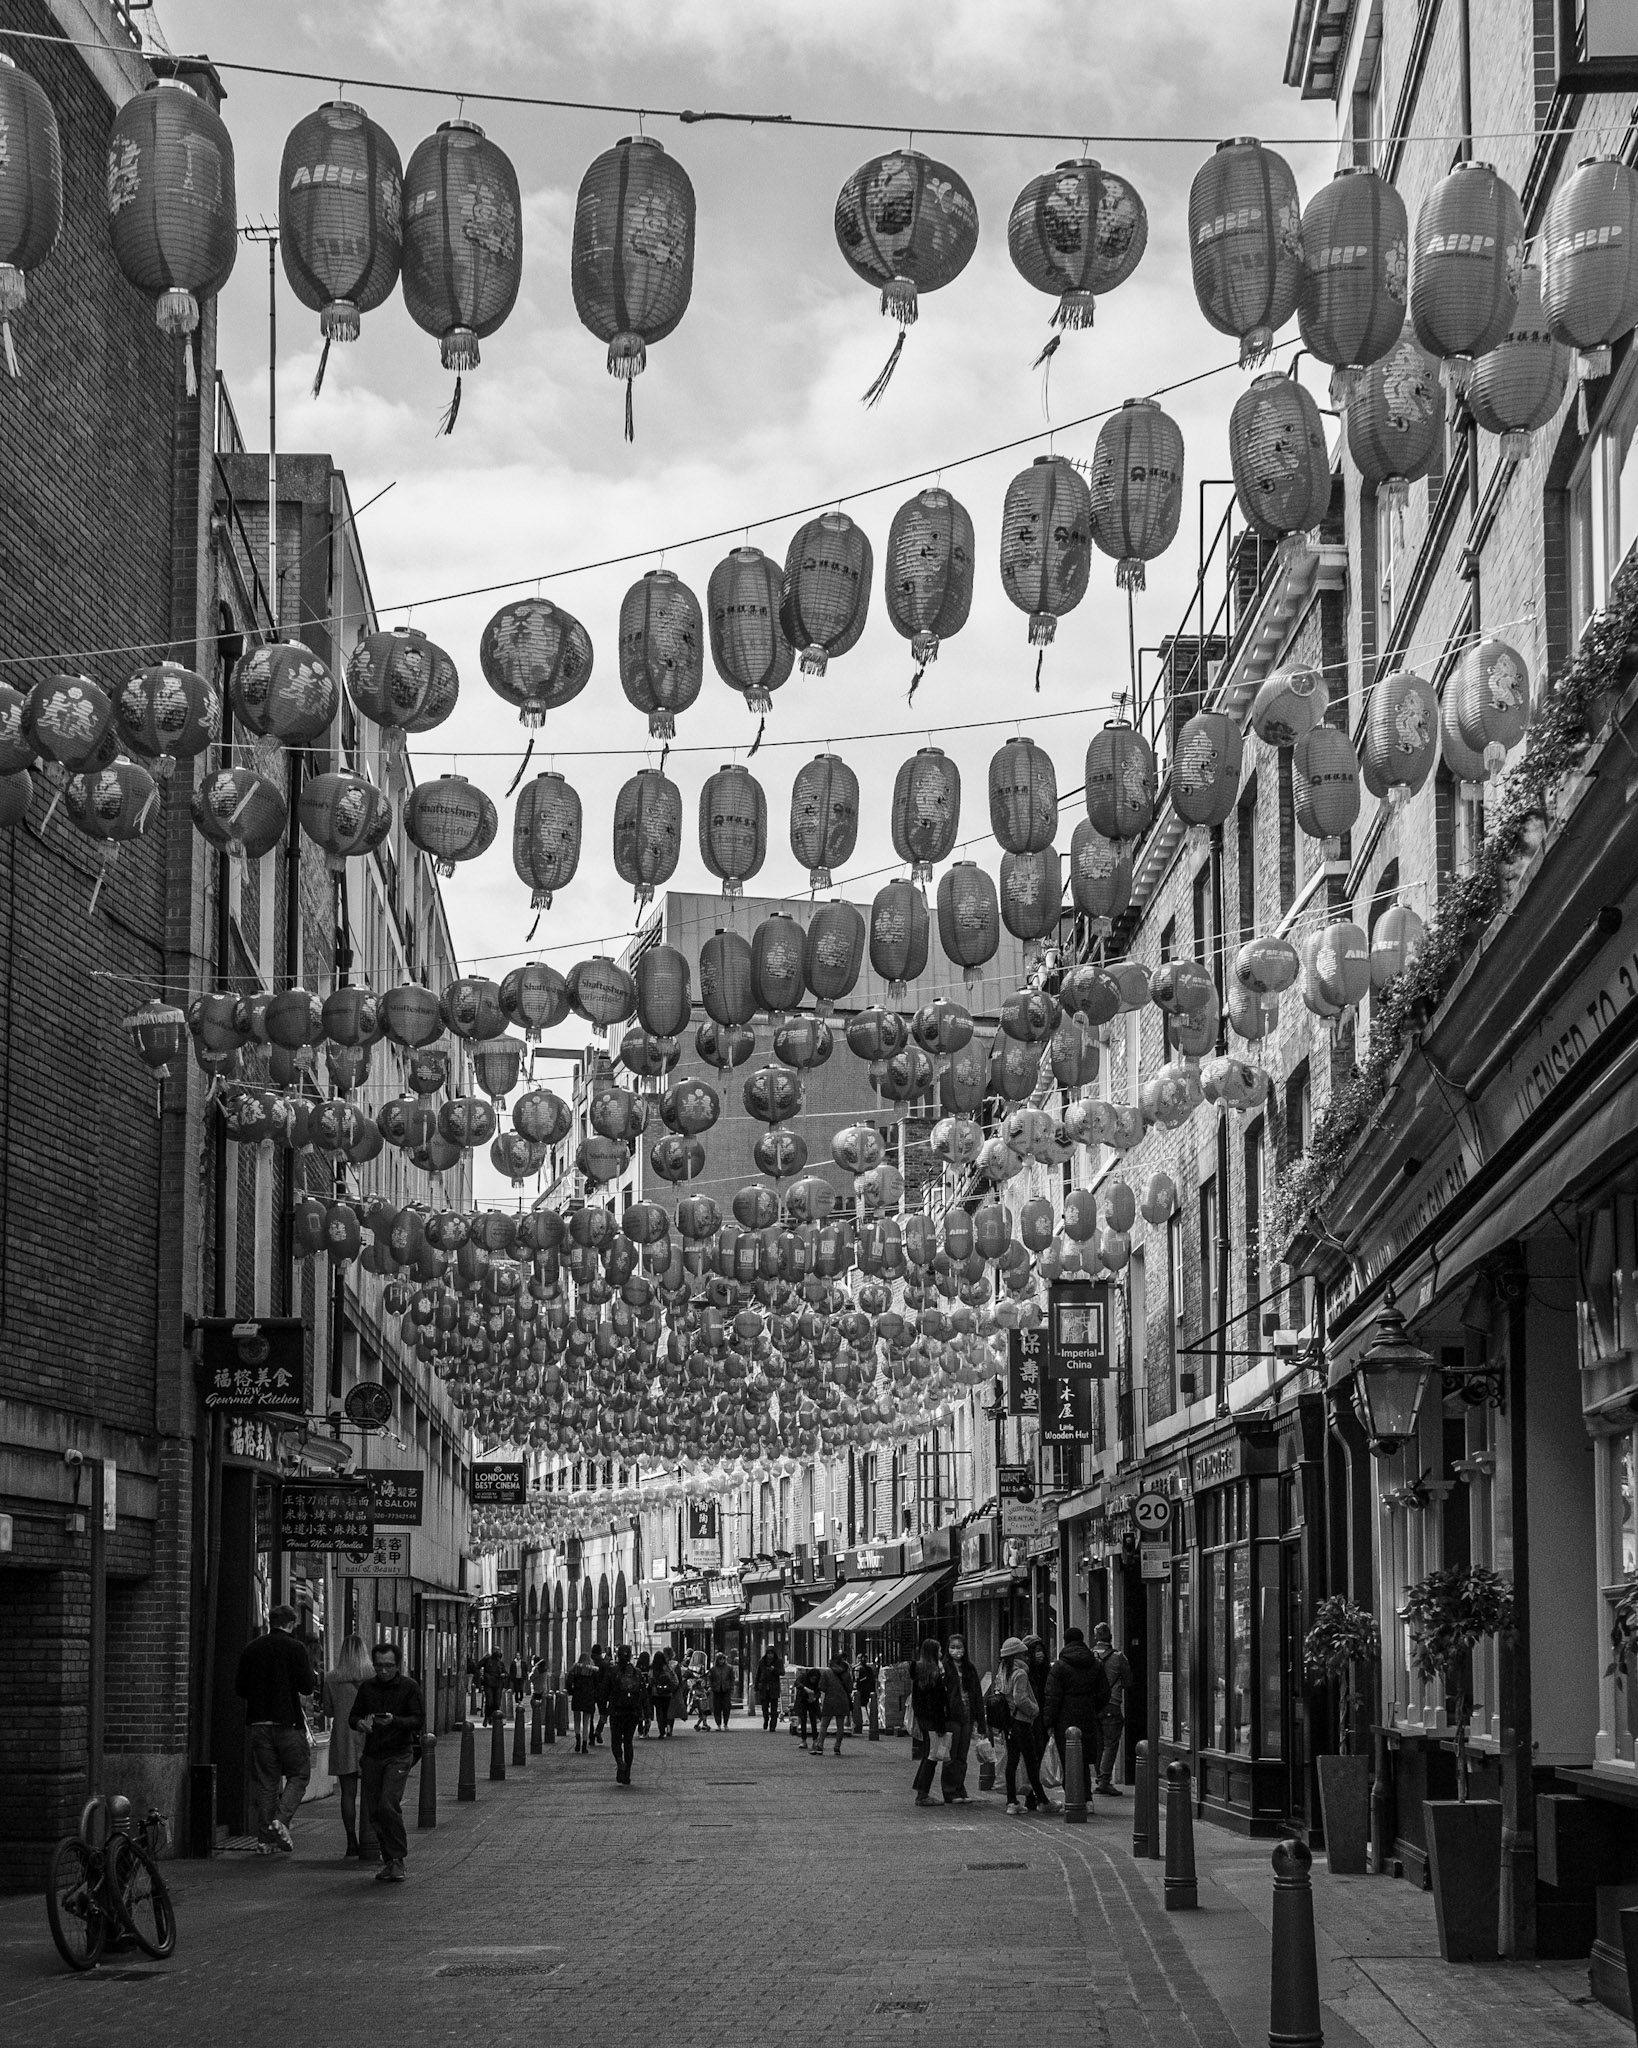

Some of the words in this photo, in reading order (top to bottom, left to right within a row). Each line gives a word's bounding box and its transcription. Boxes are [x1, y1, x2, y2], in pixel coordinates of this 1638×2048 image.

[1061, 1348, 1097, 1358] Imperial
[1066, 1360, 1092, 1369] China
[1018, 1333, 1041, 1410] 保壽堂
[214, 1367, 293, 1388] 福榕美食
[235, 1387, 261, 1395] NEW
[205, 1392, 255, 1407] Gourmet
[257, 1392, 300, 1405] Kitchen
[1044, 1431, 1074, 1440] Wooden
[1075, 1429, 1089, 1439] Hut
[475, 1472, 519, 1482] LONDON'S
[495, 1482, 521, 1490] CINEMA
[384, 1499, 417, 1508] SALON
[1139, 1503, 1168, 1520] 20
[286, 1538, 309, 1548] Home
[309, 1539, 334, 1549] Made
[335, 1539, 364, 1549] Noodles
[374, 1537, 402, 1551] 美容
[373, 1551, 401, 1565] 美甲
[345, 1564, 361, 1573] nail
[373, 1565, 401, 1575] Beauty
